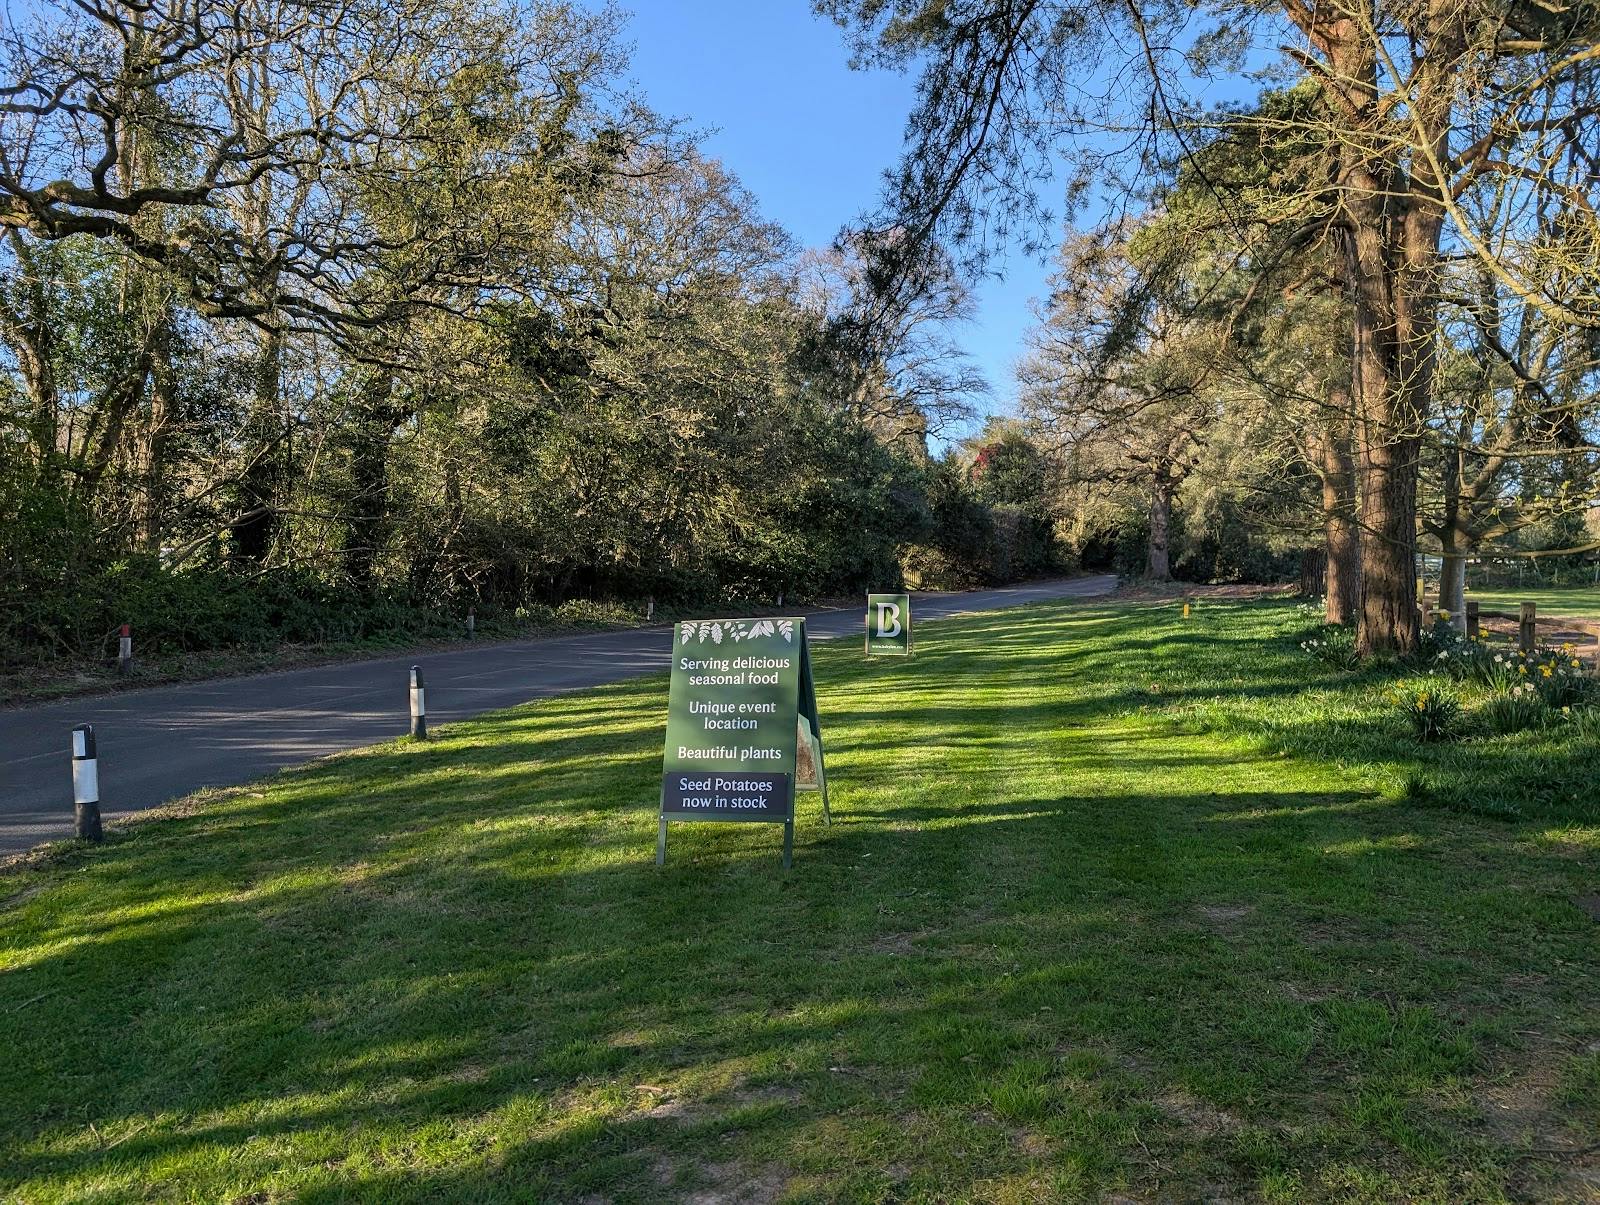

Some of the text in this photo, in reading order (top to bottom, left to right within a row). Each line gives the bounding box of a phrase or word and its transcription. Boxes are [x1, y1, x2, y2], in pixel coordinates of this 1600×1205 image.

[876, 602, 901, 638] B
[680, 656, 790, 672] Serving delicious
[689, 672, 779, 685] seasonal food
[689, 701, 777, 715] Unique event
[704, 717, 758, 730] location
[678, 746, 782, 761] Beautiful plants
[679, 777, 773, 792] Seed Potatoes
[682, 795, 768, 809] now in stock
